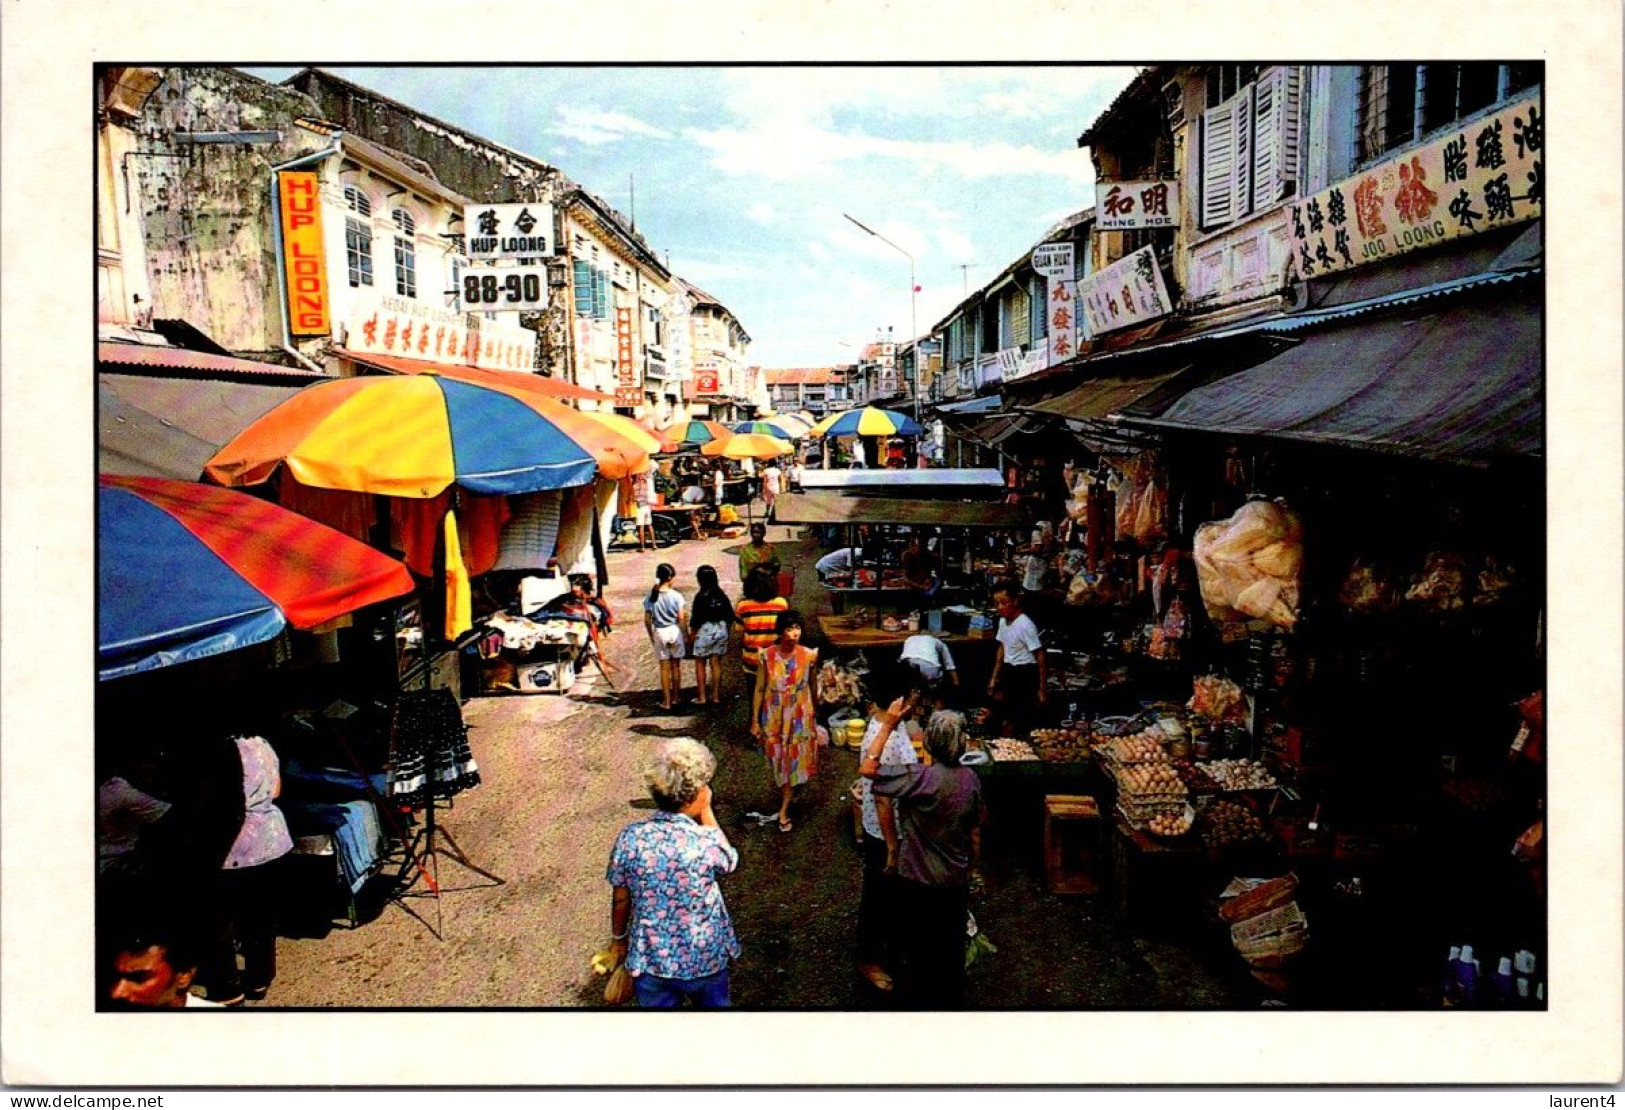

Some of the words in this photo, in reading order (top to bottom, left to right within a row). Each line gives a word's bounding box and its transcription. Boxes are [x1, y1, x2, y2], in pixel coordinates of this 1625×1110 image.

[287, 179, 314, 230] HUP
[1103, 218, 1135, 227] MING
[1145, 217, 1172, 225] HOE
[470, 237, 498, 253] HUP
[501, 236, 546, 252] LOONG
[1361, 239, 1386, 259] JOO
[1393, 220, 1446, 249] LOONG
[292, 241, 323, 329] LOONG
[464, 274, 540, 303] 88-90
